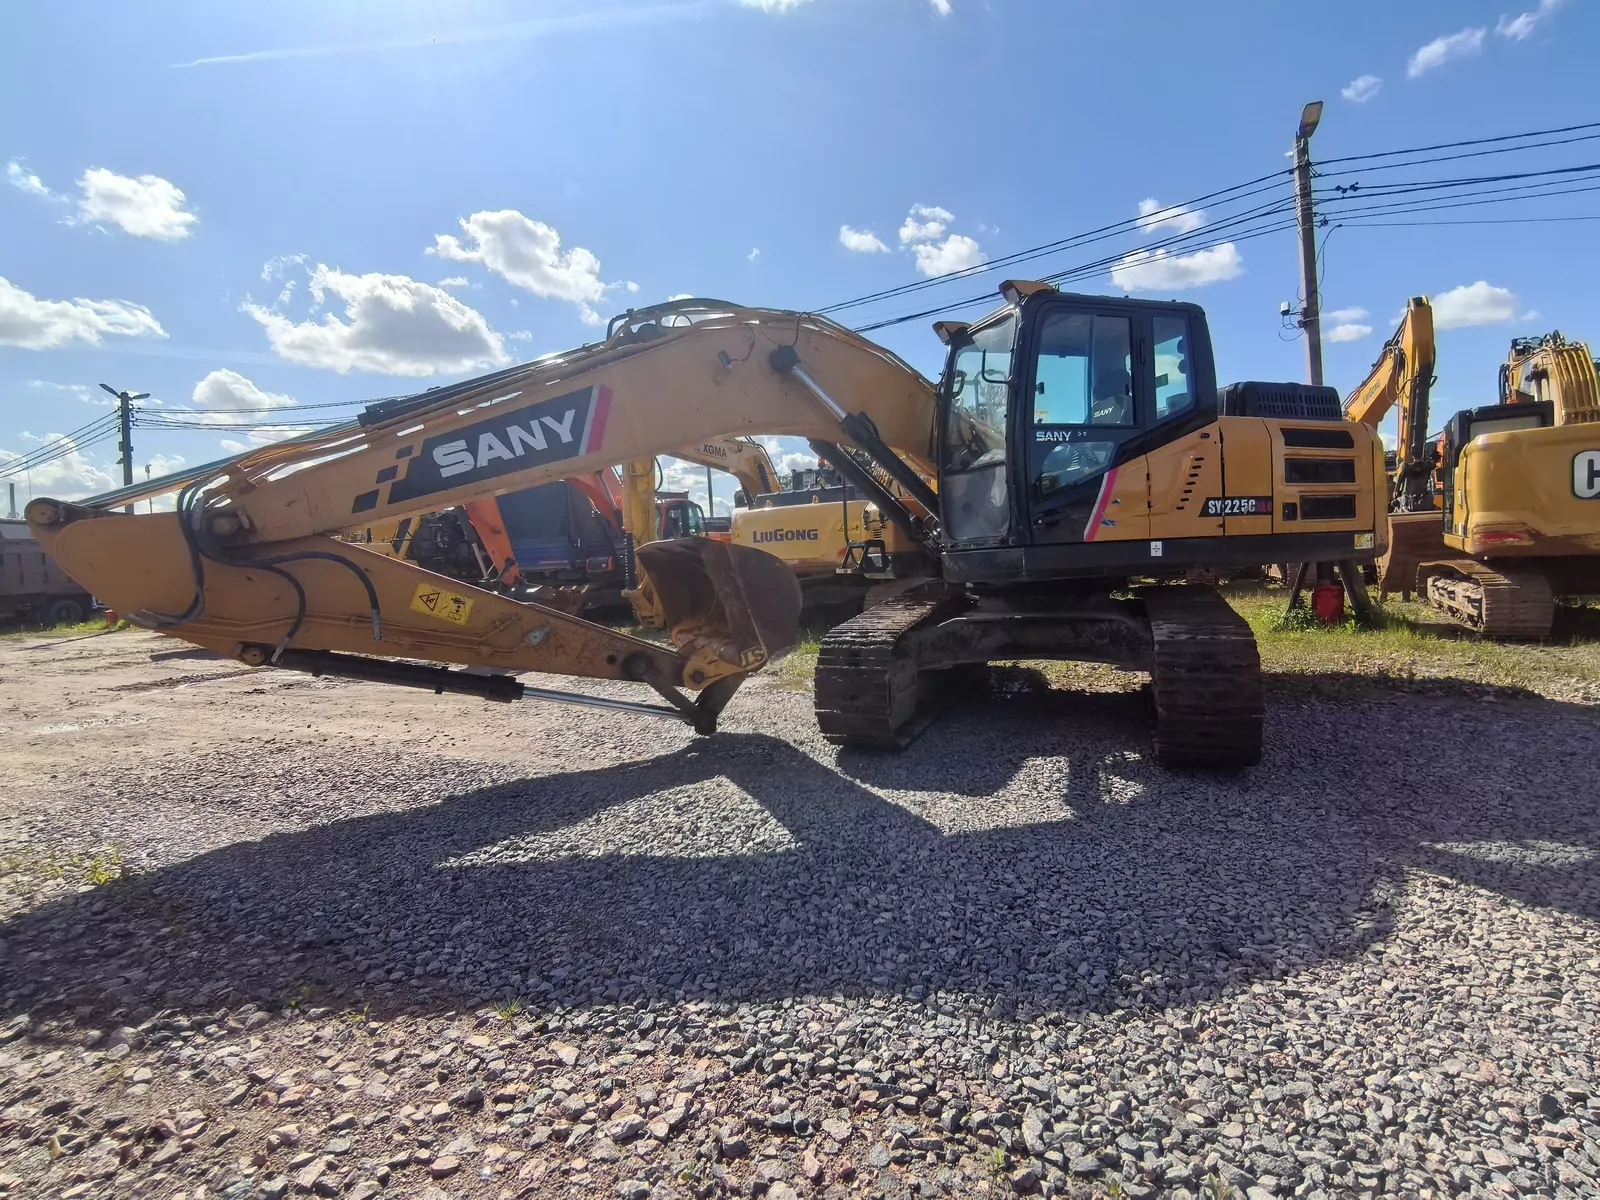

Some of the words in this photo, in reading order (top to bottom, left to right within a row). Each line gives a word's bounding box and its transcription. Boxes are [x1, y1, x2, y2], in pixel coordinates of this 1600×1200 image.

[1094, 406, 1114, 418] SANY
[432, 409, 576, 478] SANY
[1035, 431, 1072, 442] SANY
[703, 443, 728, 459] XGMA
